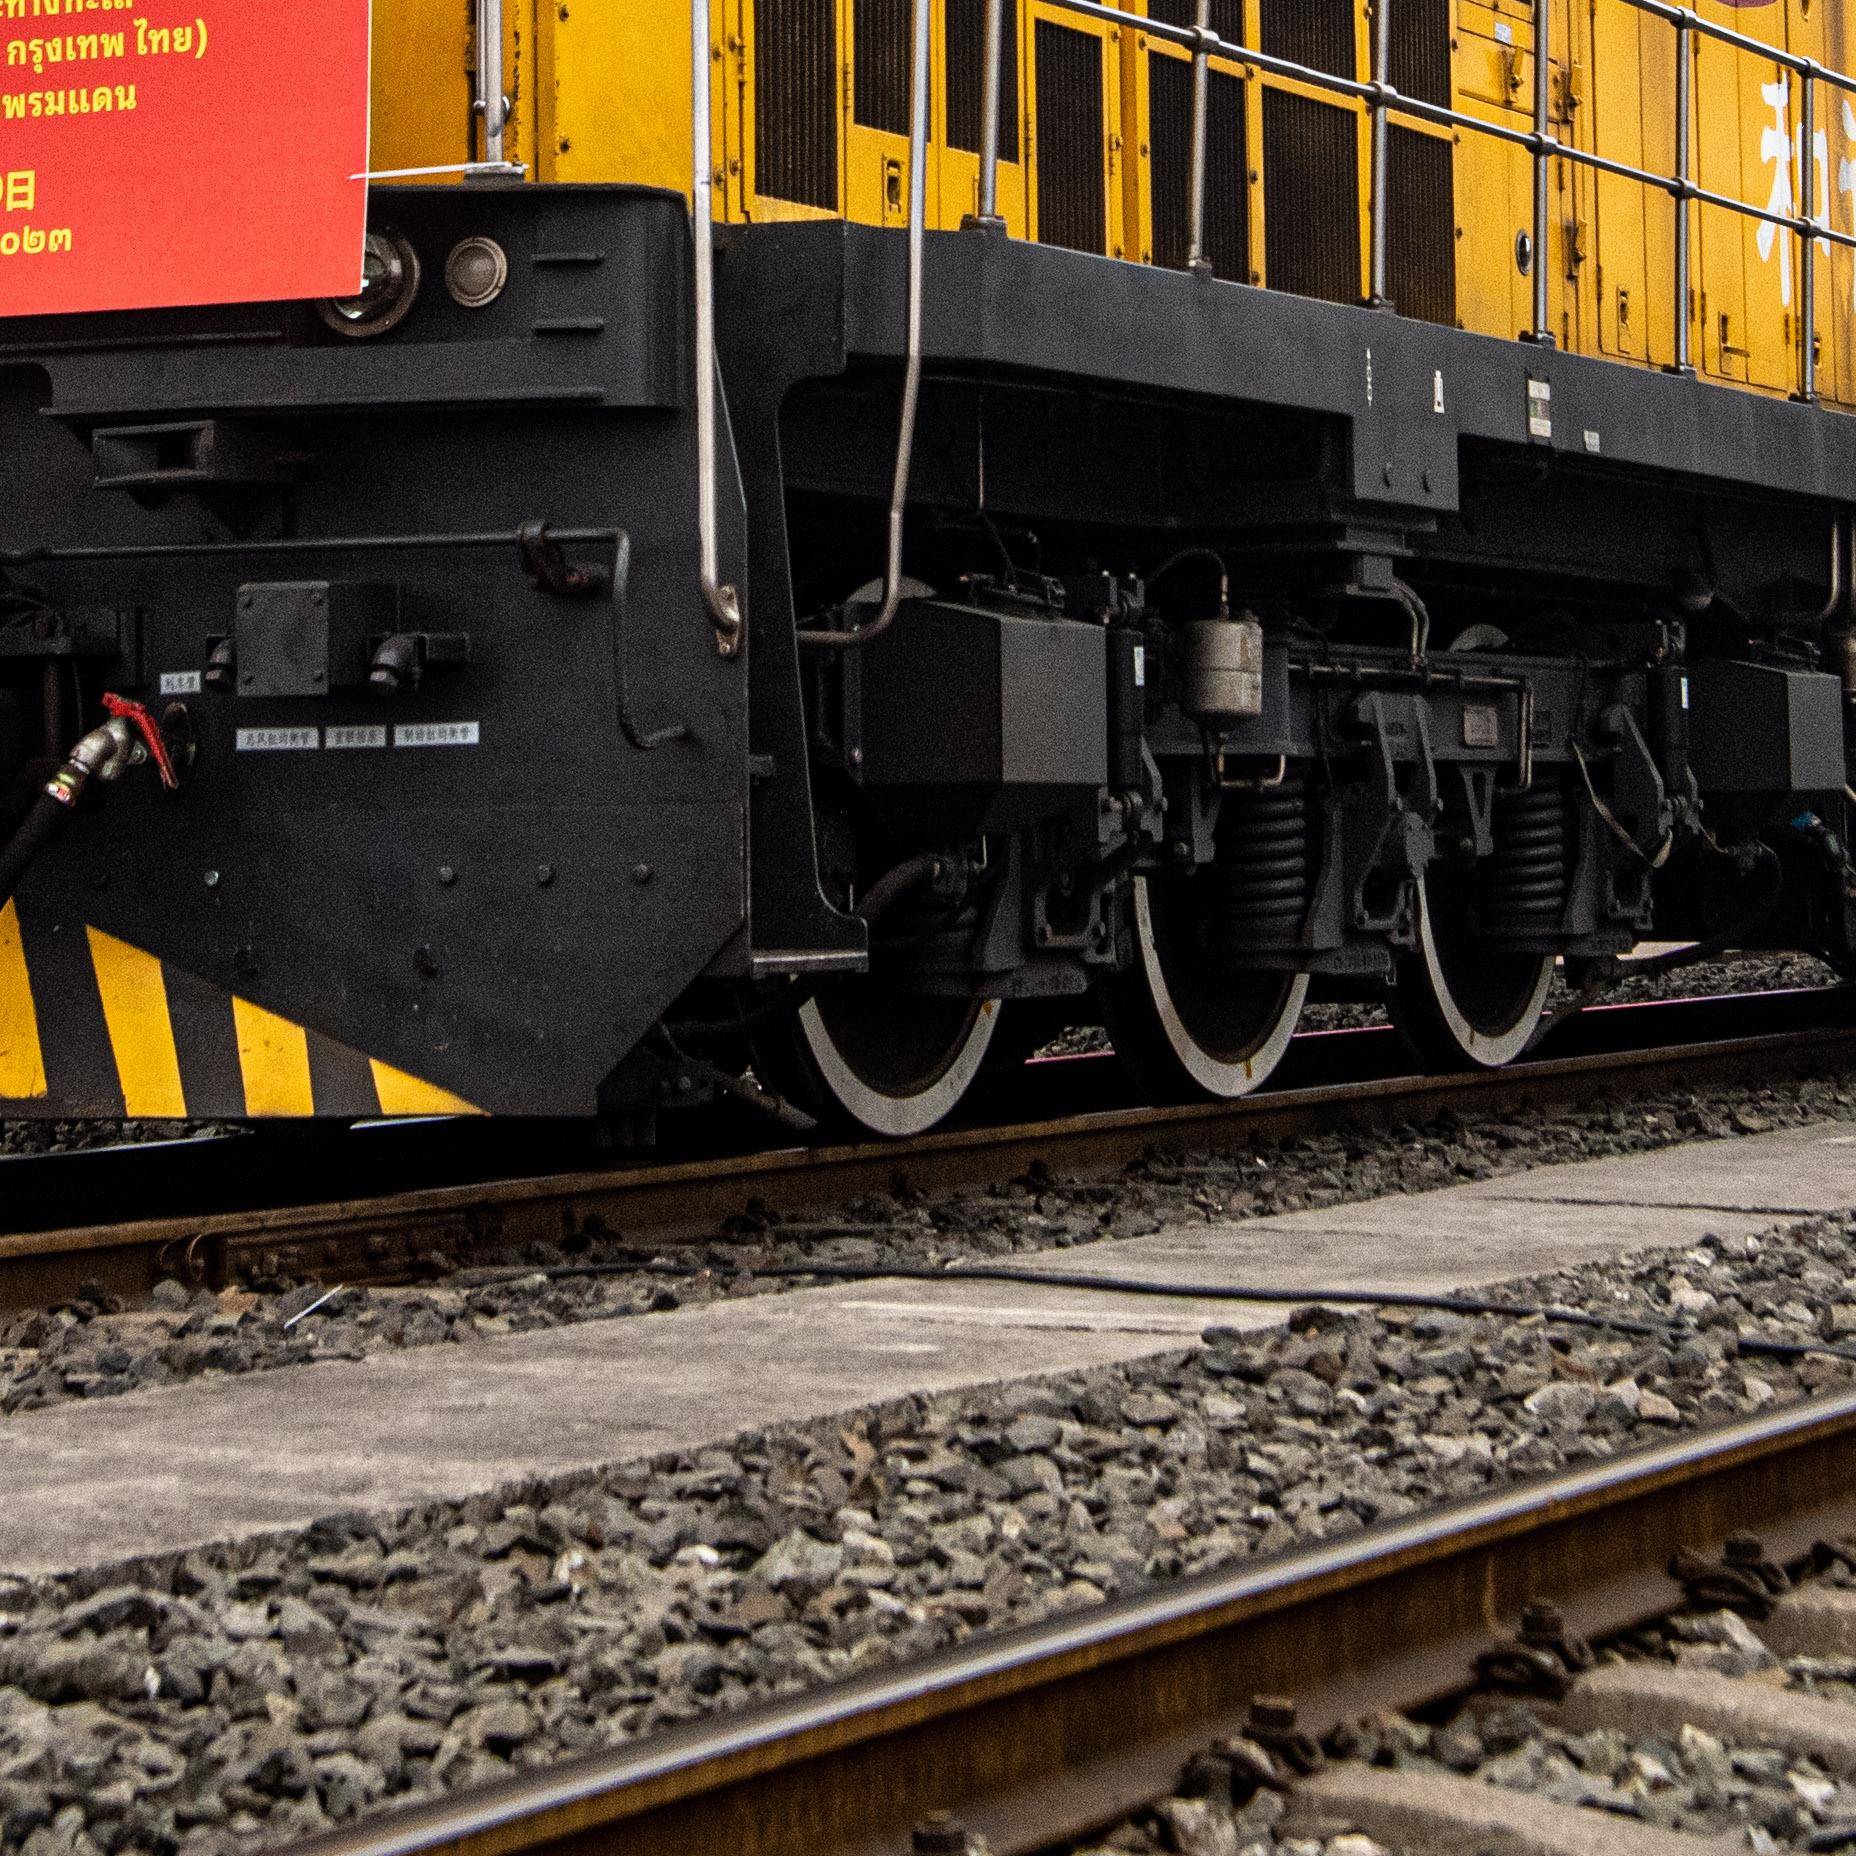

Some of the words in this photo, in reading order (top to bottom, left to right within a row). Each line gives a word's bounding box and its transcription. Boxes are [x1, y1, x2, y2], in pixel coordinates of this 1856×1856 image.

[7, 26, 125, 78] กรุงเทพ
[132, 18, 208, 59] ไทย)
